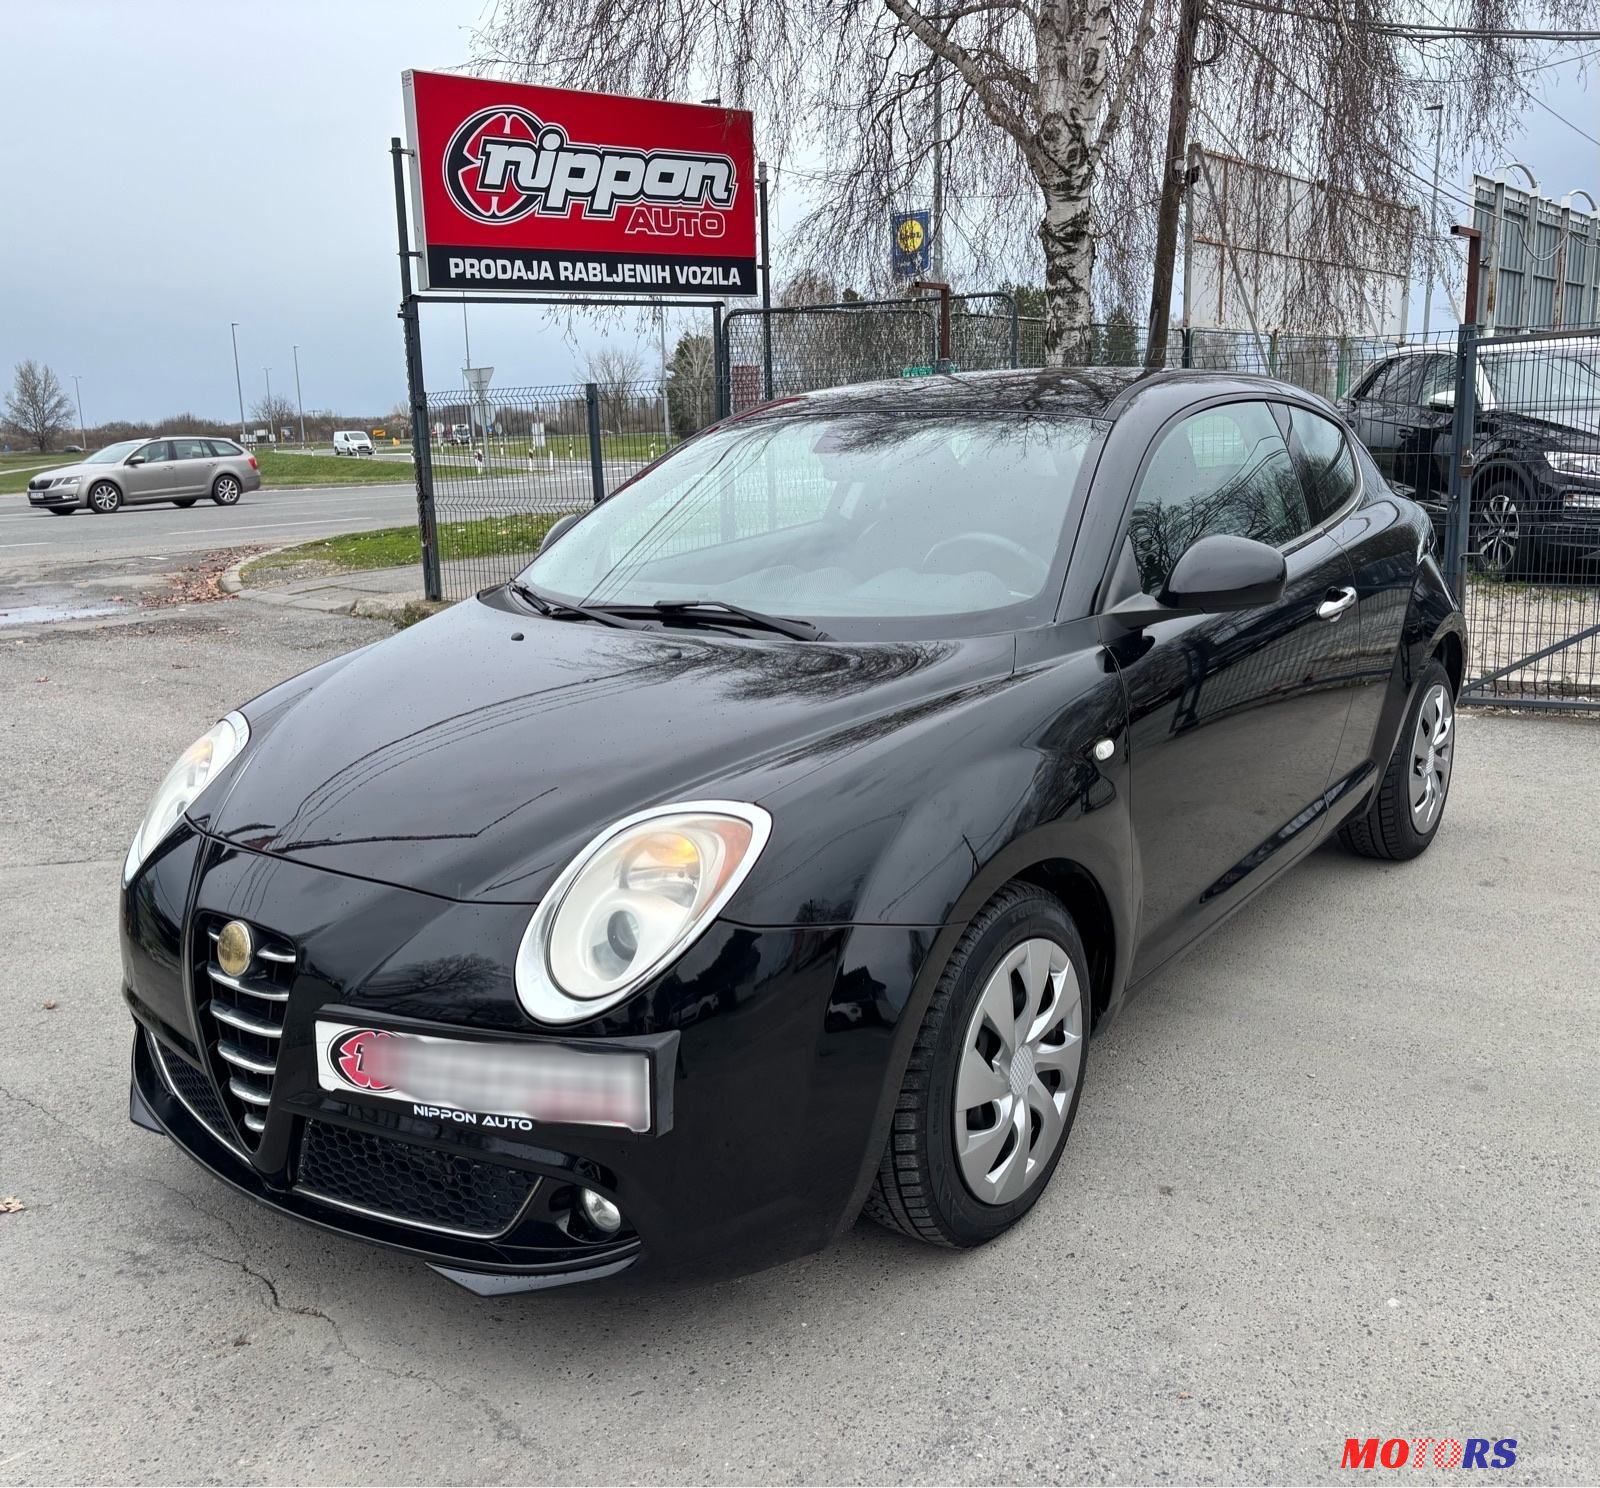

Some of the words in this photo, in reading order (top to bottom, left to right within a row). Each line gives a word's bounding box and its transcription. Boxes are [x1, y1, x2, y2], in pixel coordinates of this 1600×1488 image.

[479, 127, 736, 216] nippon
[625, 207, 726, 238] AUTO
[449, 257, 556, 281] PRODAJA
[559, 261, 670, 285] RABLJENIH
[675, 265, 742, 286] VOZILA
[413, 1104, 477, 1125] NIPPON
[482, 1115, 533, 1132] AUTO
